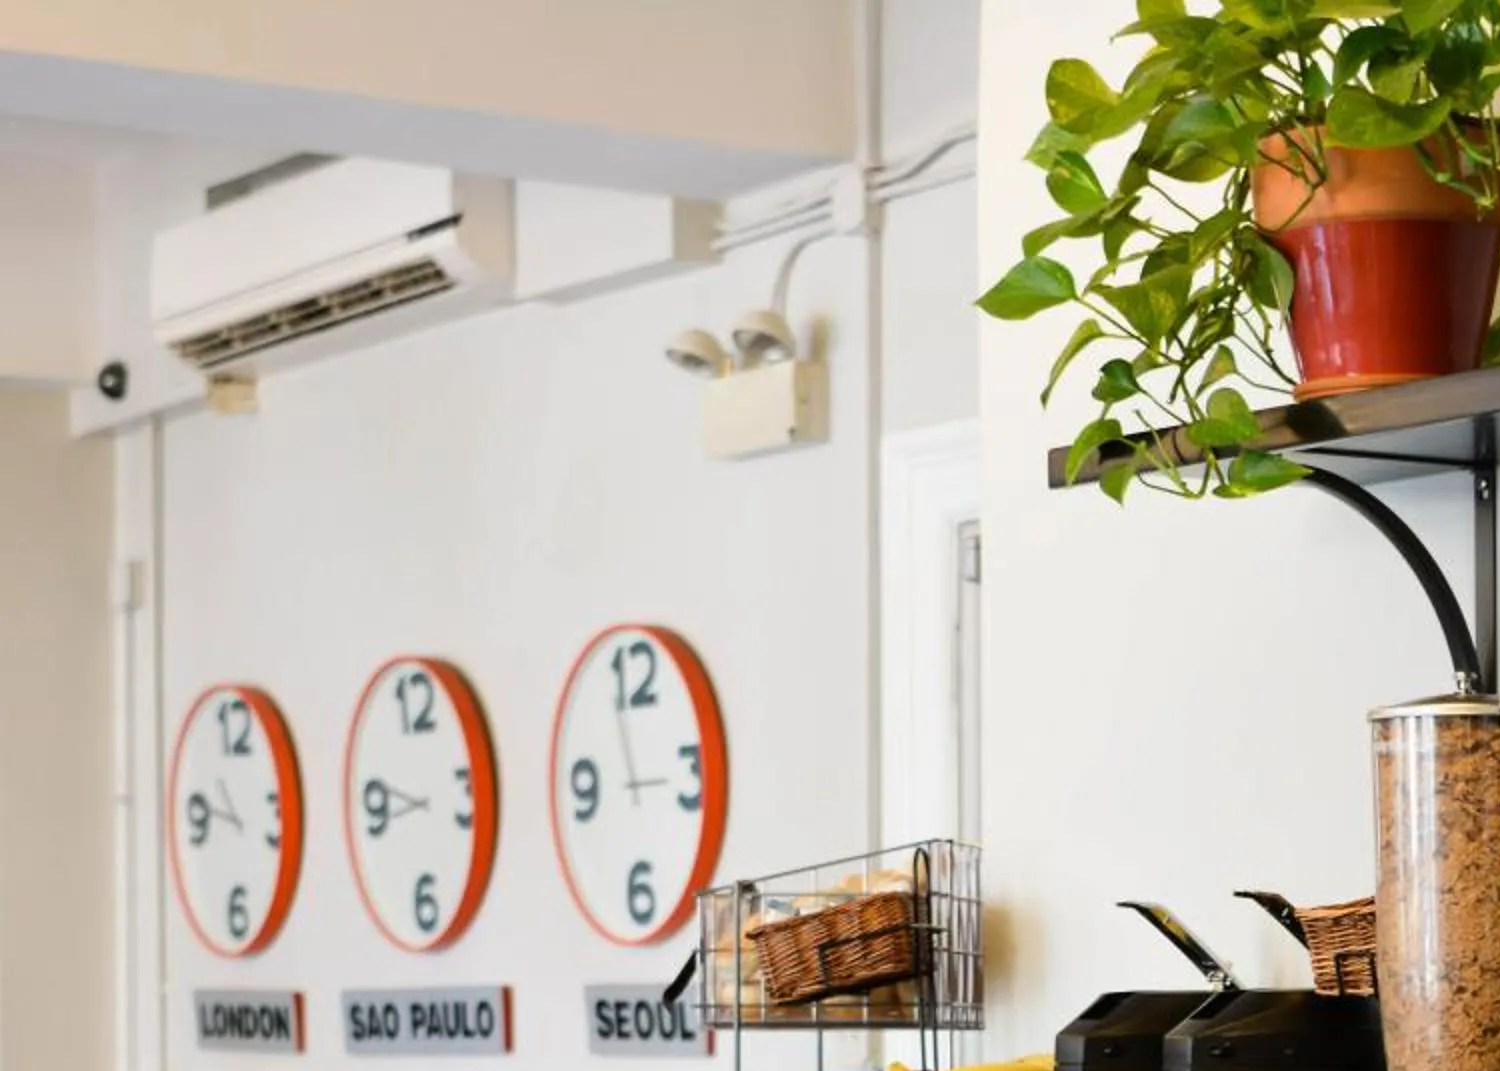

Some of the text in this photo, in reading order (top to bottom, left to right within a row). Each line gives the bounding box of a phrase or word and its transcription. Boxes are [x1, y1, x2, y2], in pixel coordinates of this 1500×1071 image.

[395, 672, 437, 735] 12
[612, 640, 658, 712] 12
[217, 699, 253, 757] 12
[364, 777, 391, 838] 9
[570, 757, 600, 823] 9
[677, 743, 703, 812] 3
[186, 792, 211, 848] 9
[227, 884, 249, 941] 6
[413, 872, 440, 933] 6
[627, 859, 656, 925] 6
[202, 1002, 291, 1041] LONDON
[350, 1000, 495, 1041] SAO PAULO
[596, 999, 696, 1041] SEOUL
